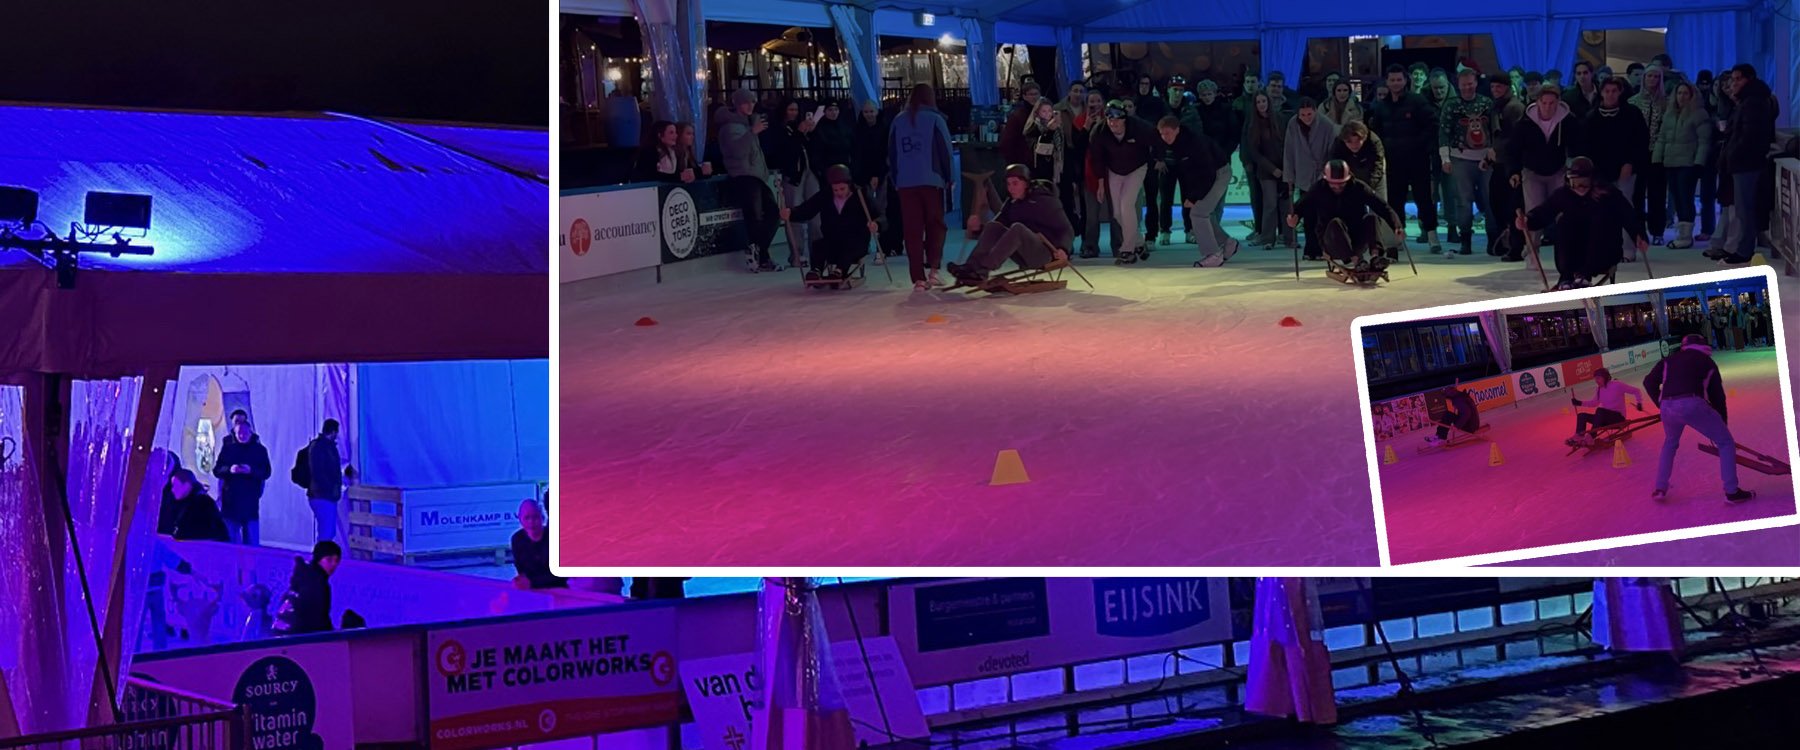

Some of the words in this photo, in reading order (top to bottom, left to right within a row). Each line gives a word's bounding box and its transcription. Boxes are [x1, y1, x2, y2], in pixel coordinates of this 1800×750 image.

[669, 201, 689, 217] DECO
[594, 220, 657, 241] accountancy
[671, 216, 691, 230] CREA
[672, 226, 693, 242] TORS
[421, 511, 500, 525] MOLENKAMP
[1105, 580, 1203, 623] EIJSINK
[471, 648, 496, 669] JE
[504, 639, 583, 665] MAAKT
[589, 634, 630, 656] HET
[447, 670, 497, 694] MET
[503, 653, 652, 687] COLORWORKS
[694, 672, 742, 697] van
[744, 663, 764, 691] d
[246, 680, 299, 698] SOURCY
[252, 708, 307, 732] itamin
[436, 719, 529, 740] COLORWORKS.NL
[252, 730, 299, 750] water
